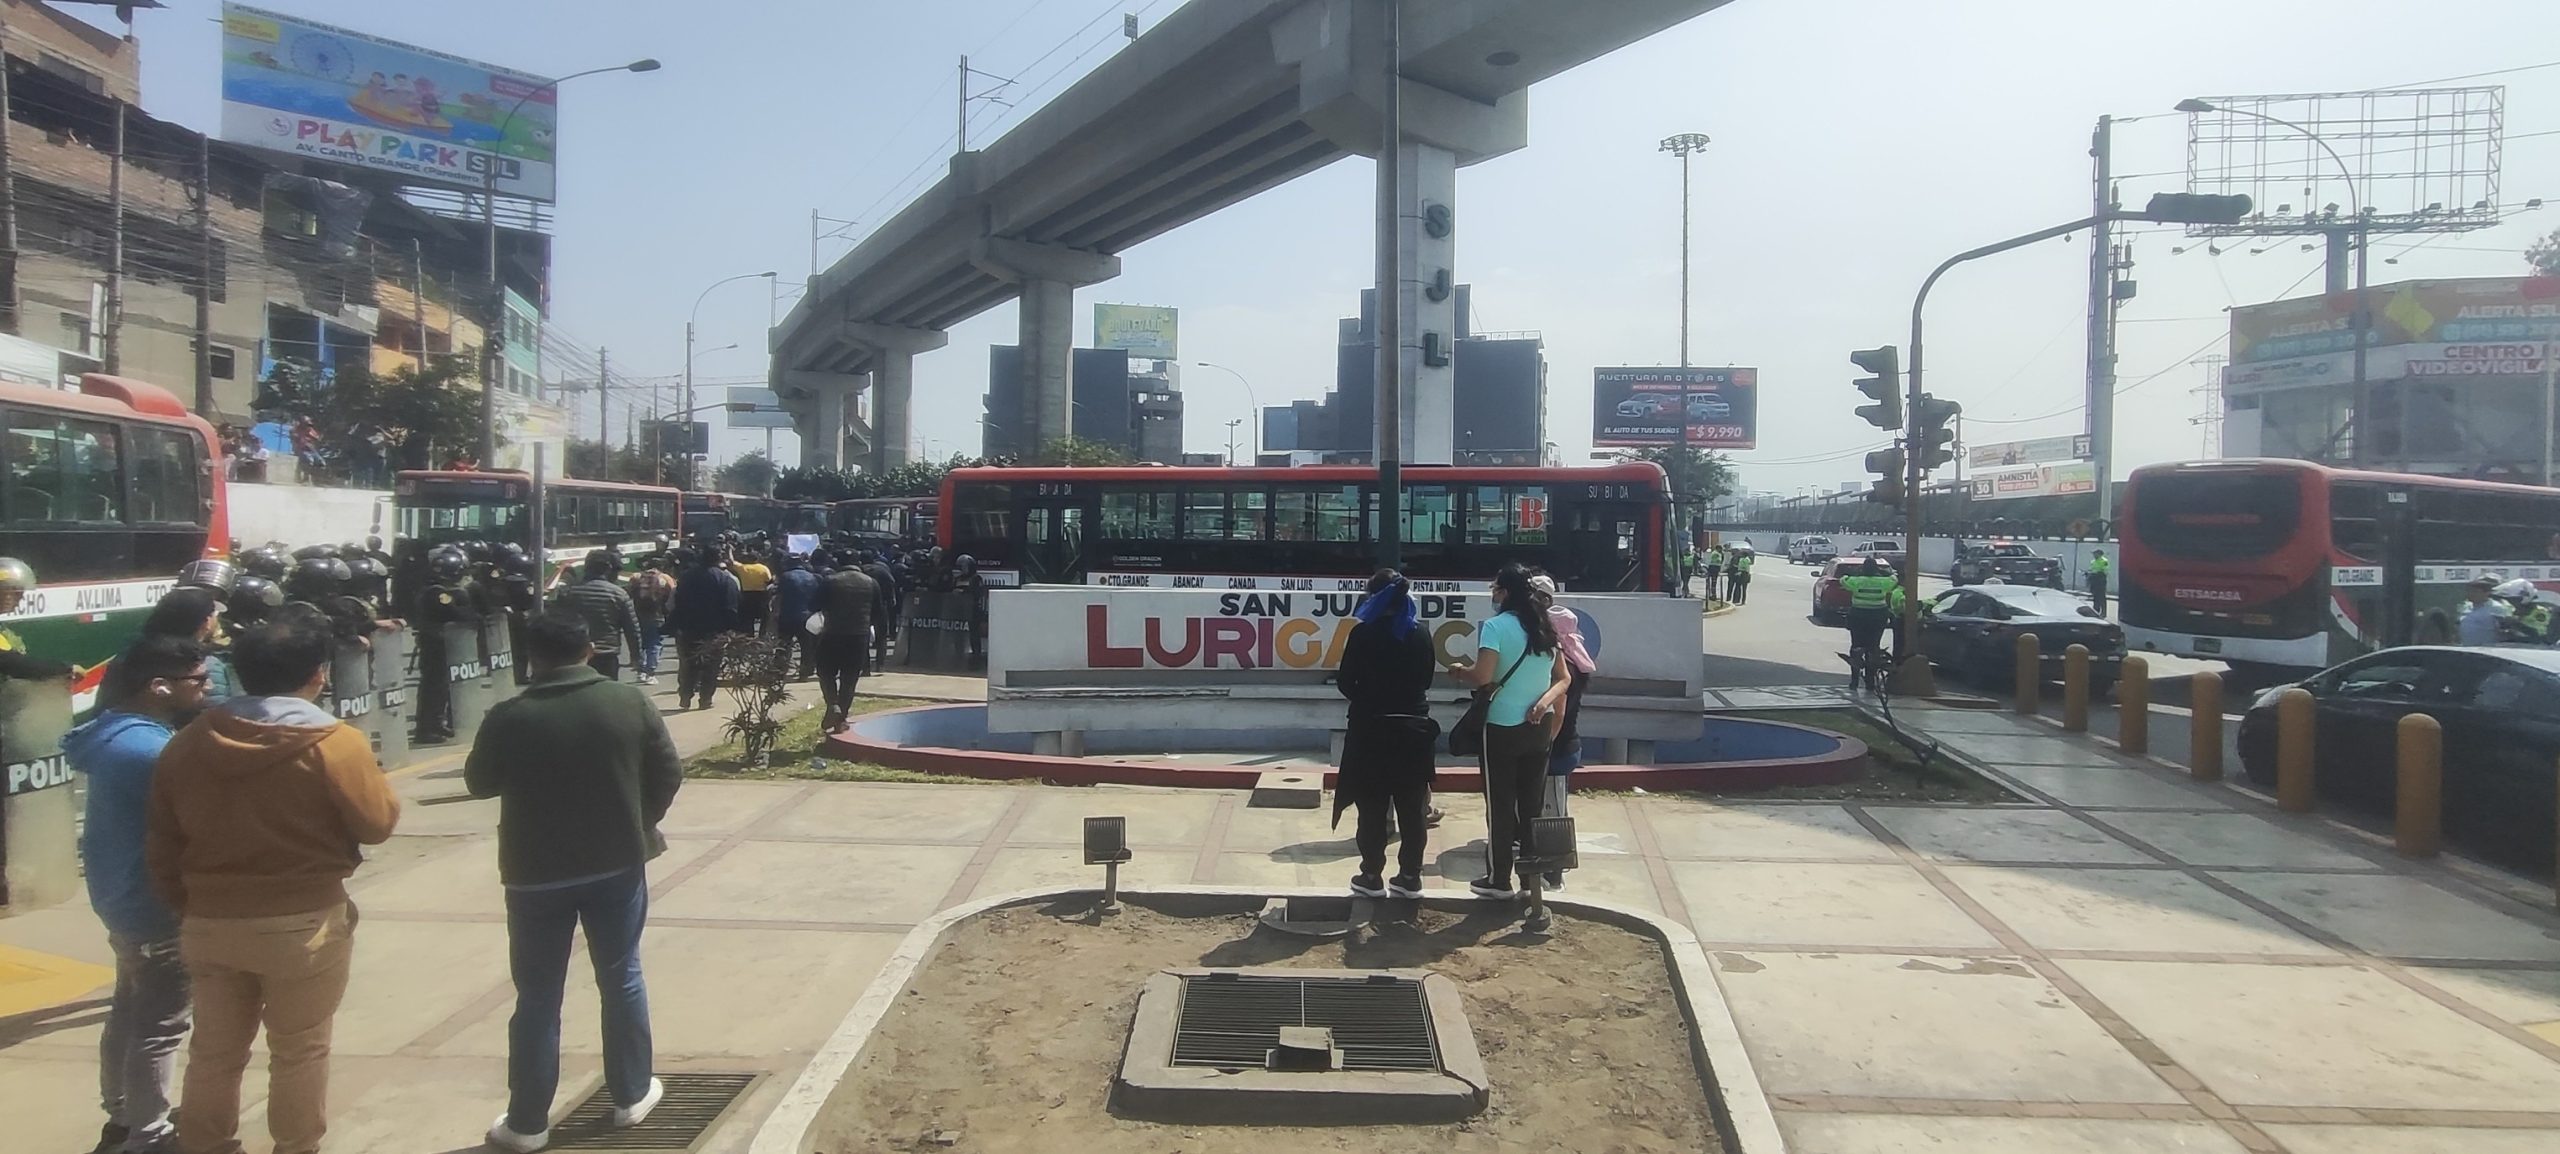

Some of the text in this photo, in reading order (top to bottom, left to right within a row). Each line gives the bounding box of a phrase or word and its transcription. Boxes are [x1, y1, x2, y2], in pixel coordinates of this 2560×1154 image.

[296, 143, 317, 153] AV.
[320, 147, 366, 162] CANTO
[368, 156, 420, 172] GRANDE
[297, 120, 516, 177] PLAY PARK SL
[2444, 345, 2535, 359] CENTRO
[1707, 426, 1743, 438] 9,990
[2076, 443, 2091, 455] 31
[1976, 483, 1990, 495] 30
[1518, 497, 1545, 530] B
[1107, 575, 1150, 587] CTO.GRANDE
[1173, 576, 1205, 589] ABANCAY
[1228, 577, 1257, 589] CANADA
[1281, 578, 1295, 590] SAN
[1297, 578, 1313, 591] LUIS
[1413, 581, 1433, 592] PISTA
[75, 587, 122, 611] AV.LIMA
[1219, 593, 1291, 617] SAN
[1421, 594, 1466, 618] DE
